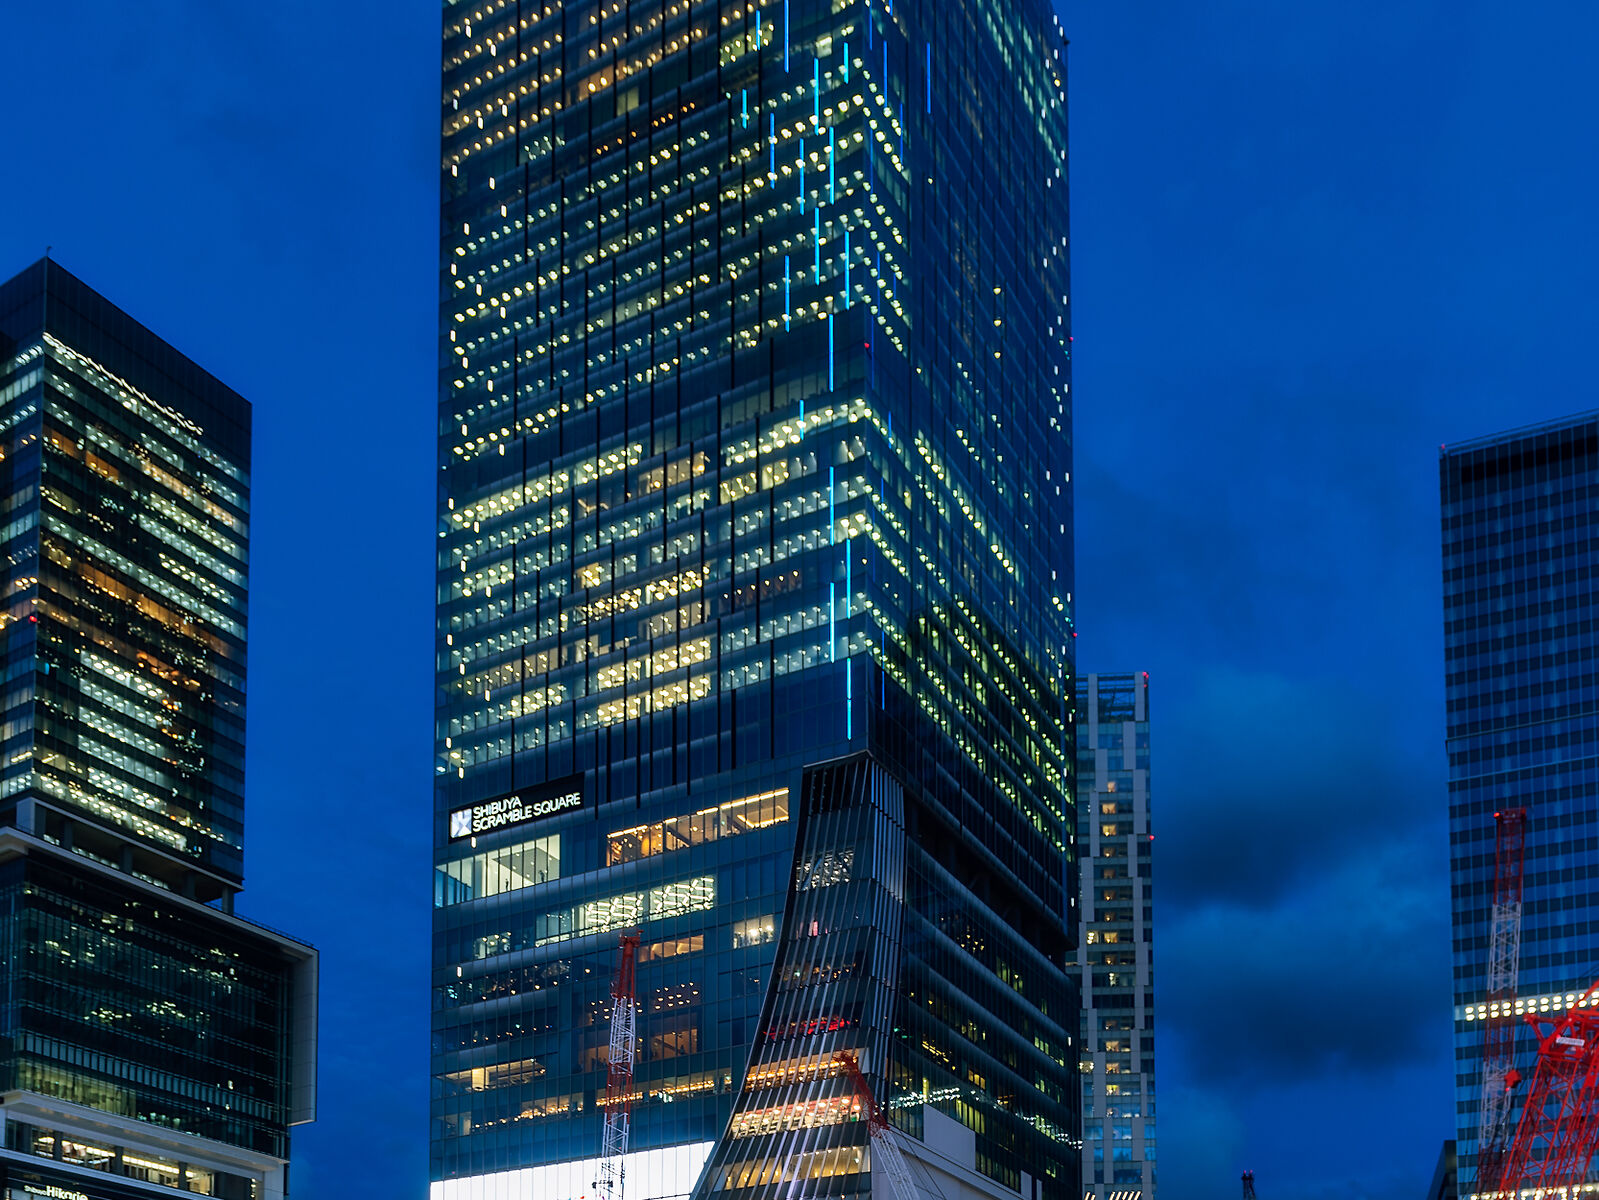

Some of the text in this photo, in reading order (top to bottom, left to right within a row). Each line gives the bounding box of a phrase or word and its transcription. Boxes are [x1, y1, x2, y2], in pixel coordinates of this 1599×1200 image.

[472, 796, 523, 820] SHIBUYA
[472, 792, 581, 833] SCRAMBLE SQUARE
